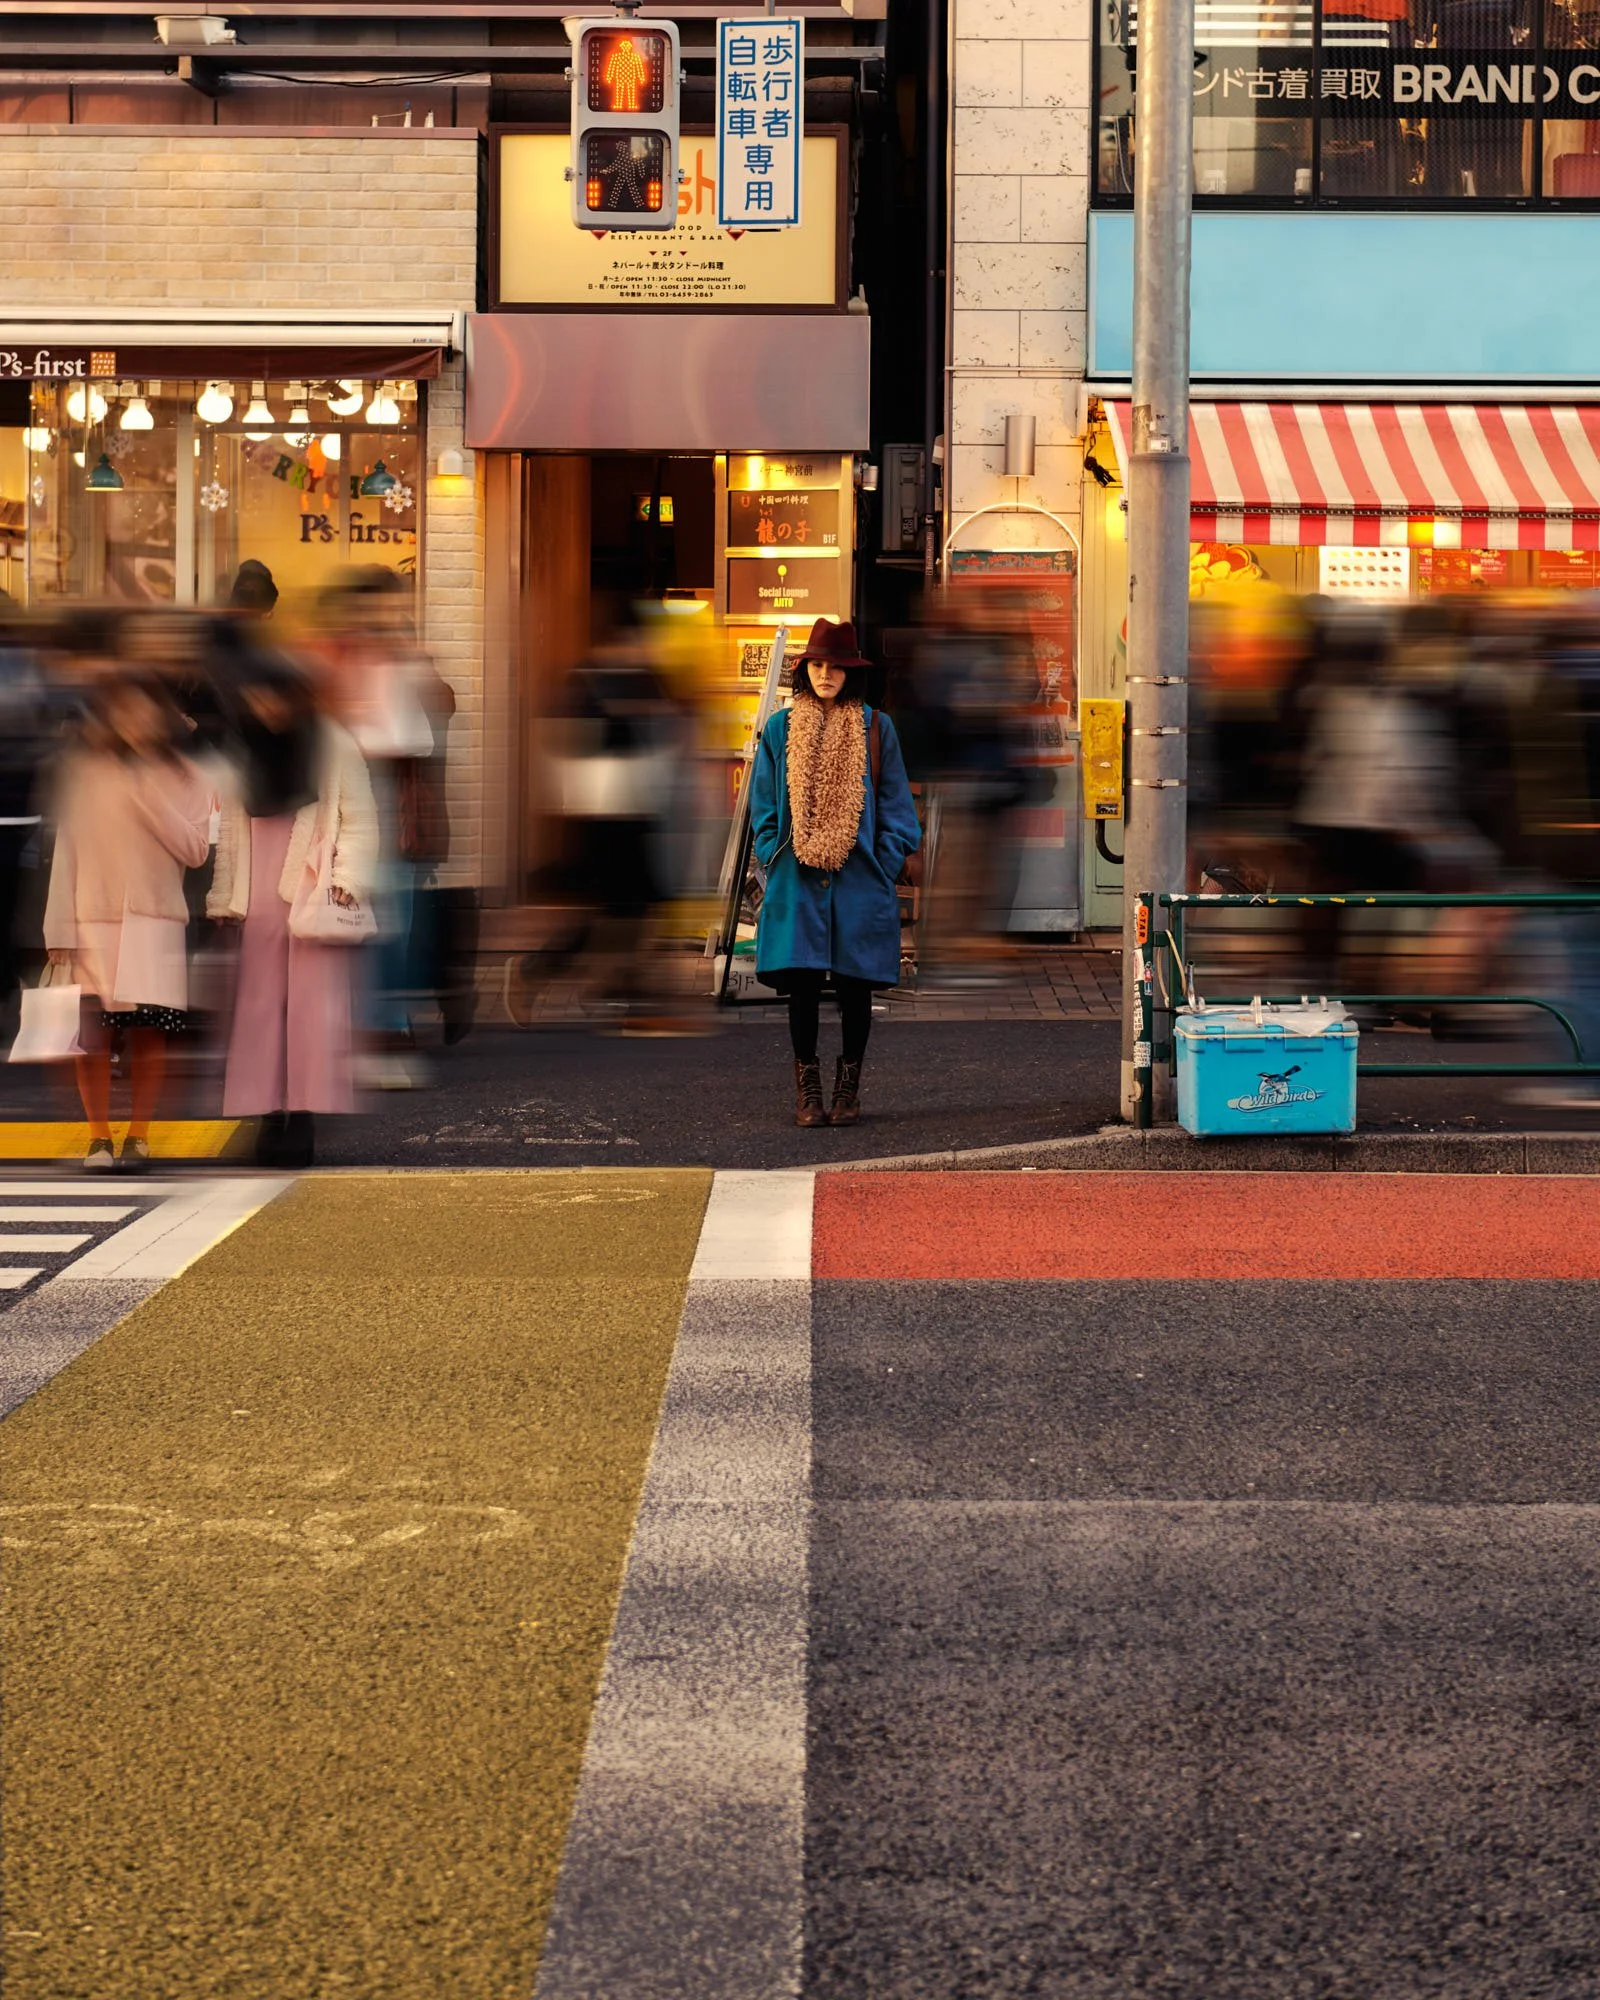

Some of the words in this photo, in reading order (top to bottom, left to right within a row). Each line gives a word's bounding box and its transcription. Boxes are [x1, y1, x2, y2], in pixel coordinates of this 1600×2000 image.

[726, 35, 757, 139] 自転車
[762, 35, 793, 138] 歩行者
[1130, 67, 1382, 100] ンド古着買取
[1393, 64, 1560, 104] BRAND
[744, 143, 774, 211] 専用
[755, 517, 812, 544] 龍の子
[822, 533, 837, 545] B1F
[758, 587, 782, 598] Social
[782, 587, 809, 599] Lounge
[773, 598, 794, 608] AJITO
